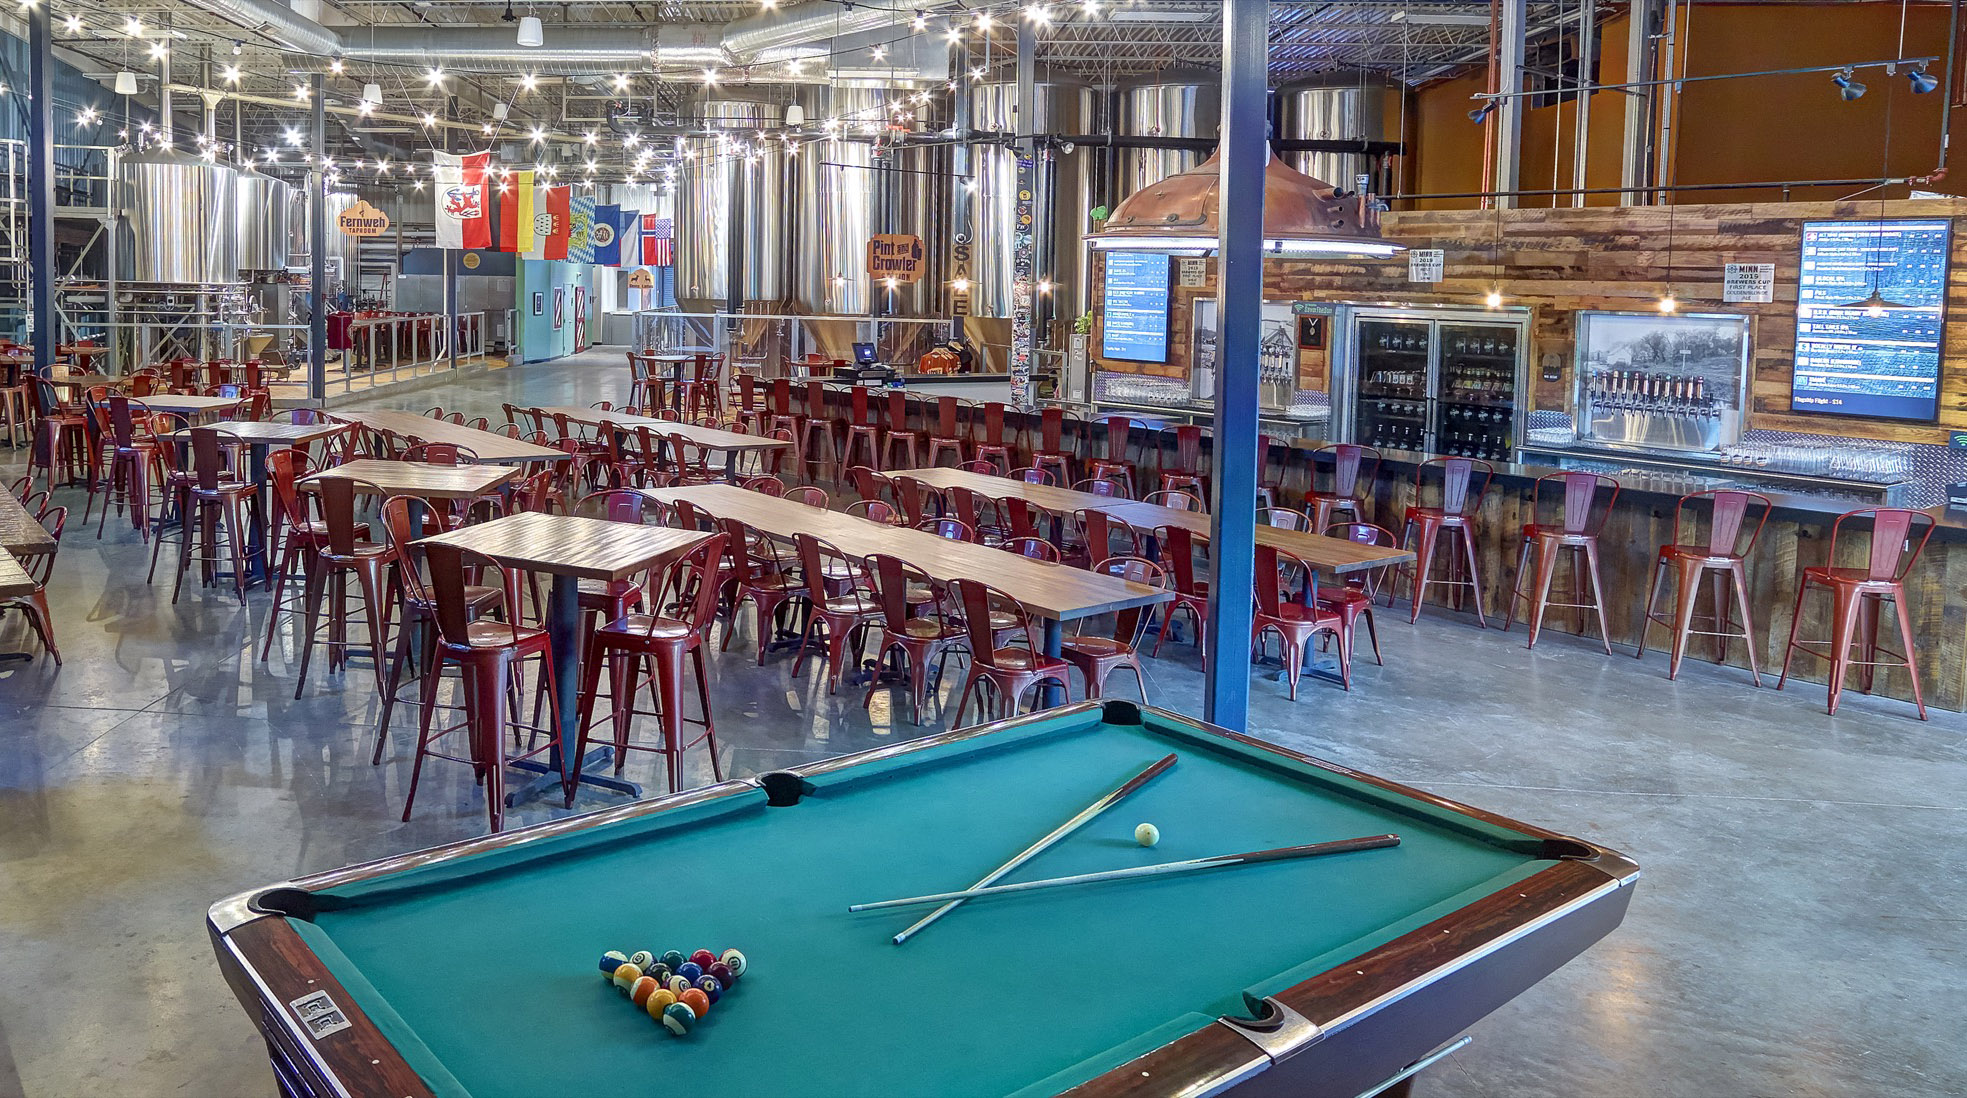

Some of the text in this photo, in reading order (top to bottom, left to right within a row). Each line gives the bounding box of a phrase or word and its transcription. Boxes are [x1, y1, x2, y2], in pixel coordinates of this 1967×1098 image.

[340, 216, 386, 228] Fernweh
[873, 240, 895, 255] Pint
[873, 255, 917, 271] Crowler
[1739, 265, 1759, 273] MINN
